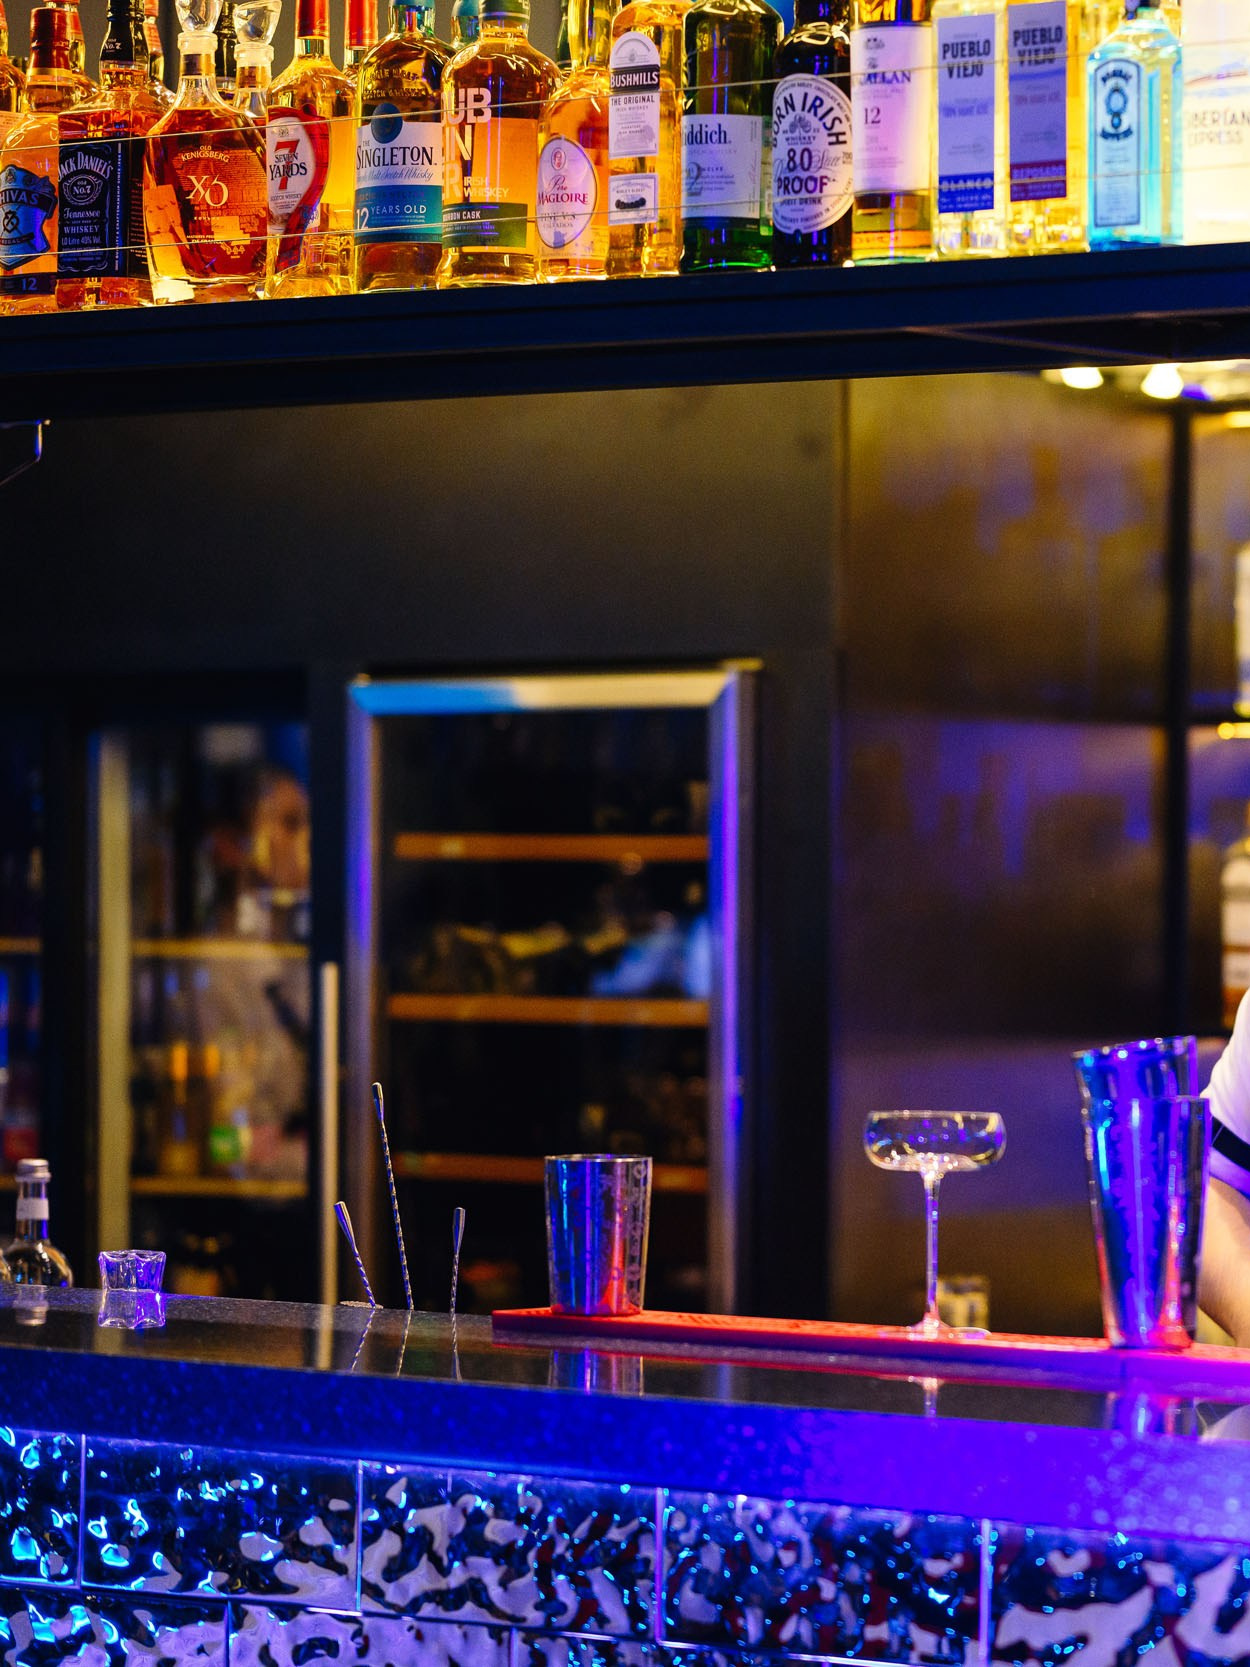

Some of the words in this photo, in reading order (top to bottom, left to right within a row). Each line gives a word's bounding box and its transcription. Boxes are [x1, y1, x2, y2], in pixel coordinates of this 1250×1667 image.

[1013, 25, 1063, 47] PUEBLO
[942, 39, 991, 60] PUEBLO
[1017, 47, 1056, 67] VIEJO
[946, 62, 984, 79] VIEJO
[610, 71, 658, 88] BUSHMILLS
[611, 97, 621, 106] THE
[624, 95, 655, 105] ORIGINAL
[801, 92, 847, 146] IRISH
[864, 106, 881, 125] 12
[362, 139, 370, 147] THE
[181, 150, 231, 163] KENIGSBERG
[273, 139, 300, 191] 7
[274, 152, 298, 164] SEVEN
[356, 145, 434, 170] SINGLETON
[787, 148, 813, 172] 80
[58, 157, 77, 182] JACK
[77, 151, 114, 180] DANIEL'S
[269, 161, 308, 181] YARDS
[404, 167, 434, 182] Whisky
[73, 185, 91, 195] No.7
[463, 176, 488, 187] IRISH
[777, 175, 829, 196] PROOF
[0, 190, 39, 205] HIVAS
[185, 174, 229, 207] XO
[463, 187, 510, 198] WHISKEY
[538, 191, 589, 205] MAGLOIRE
[63, 207, 101, 219] Tennessee
[356, 207, 369, 230] 12
[370, 205, 400, 215] YEARS
[403, 204, 427, 214] OLD
[462, 211, 481, 219] CASK
[63, 225, 100, 234] WHISKEY
[21, 278, 37, 291] 12
